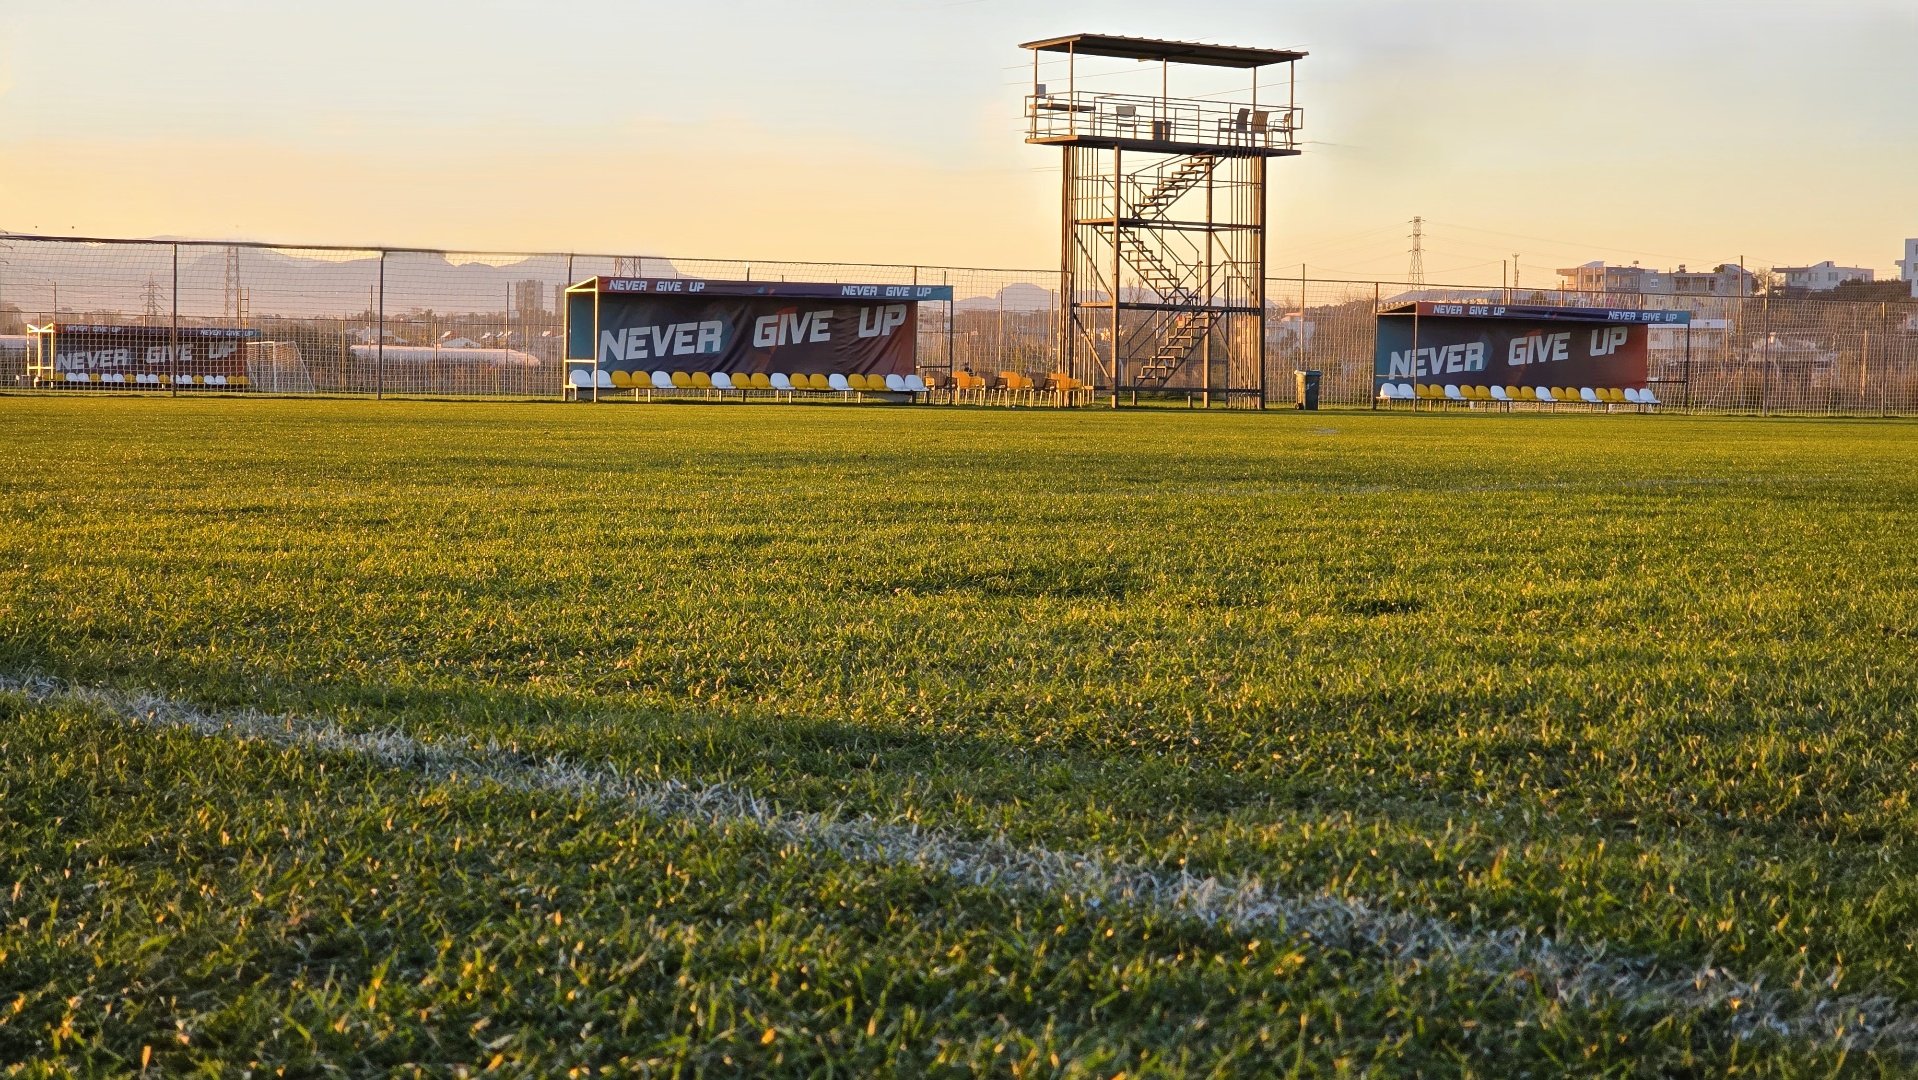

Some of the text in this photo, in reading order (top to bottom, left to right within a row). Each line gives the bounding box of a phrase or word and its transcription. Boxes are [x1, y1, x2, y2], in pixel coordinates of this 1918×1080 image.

[609, 280, 705, 292] NEVER GIVE UP
[841, 286, 932, 297] NEVER GIVE UP
[1433, 305, 1506, 316] NEVER GIVE UP
[1608, 310, 1678, 322] NEVER GIVE UP
[598, 304, 907, 363] NEVER GIVE UP
[56, 348, 128, 370] NEVER
[208, 340, 237, 359] UP
[1389, 326, 1628, 380] NEVER GIVE UP
